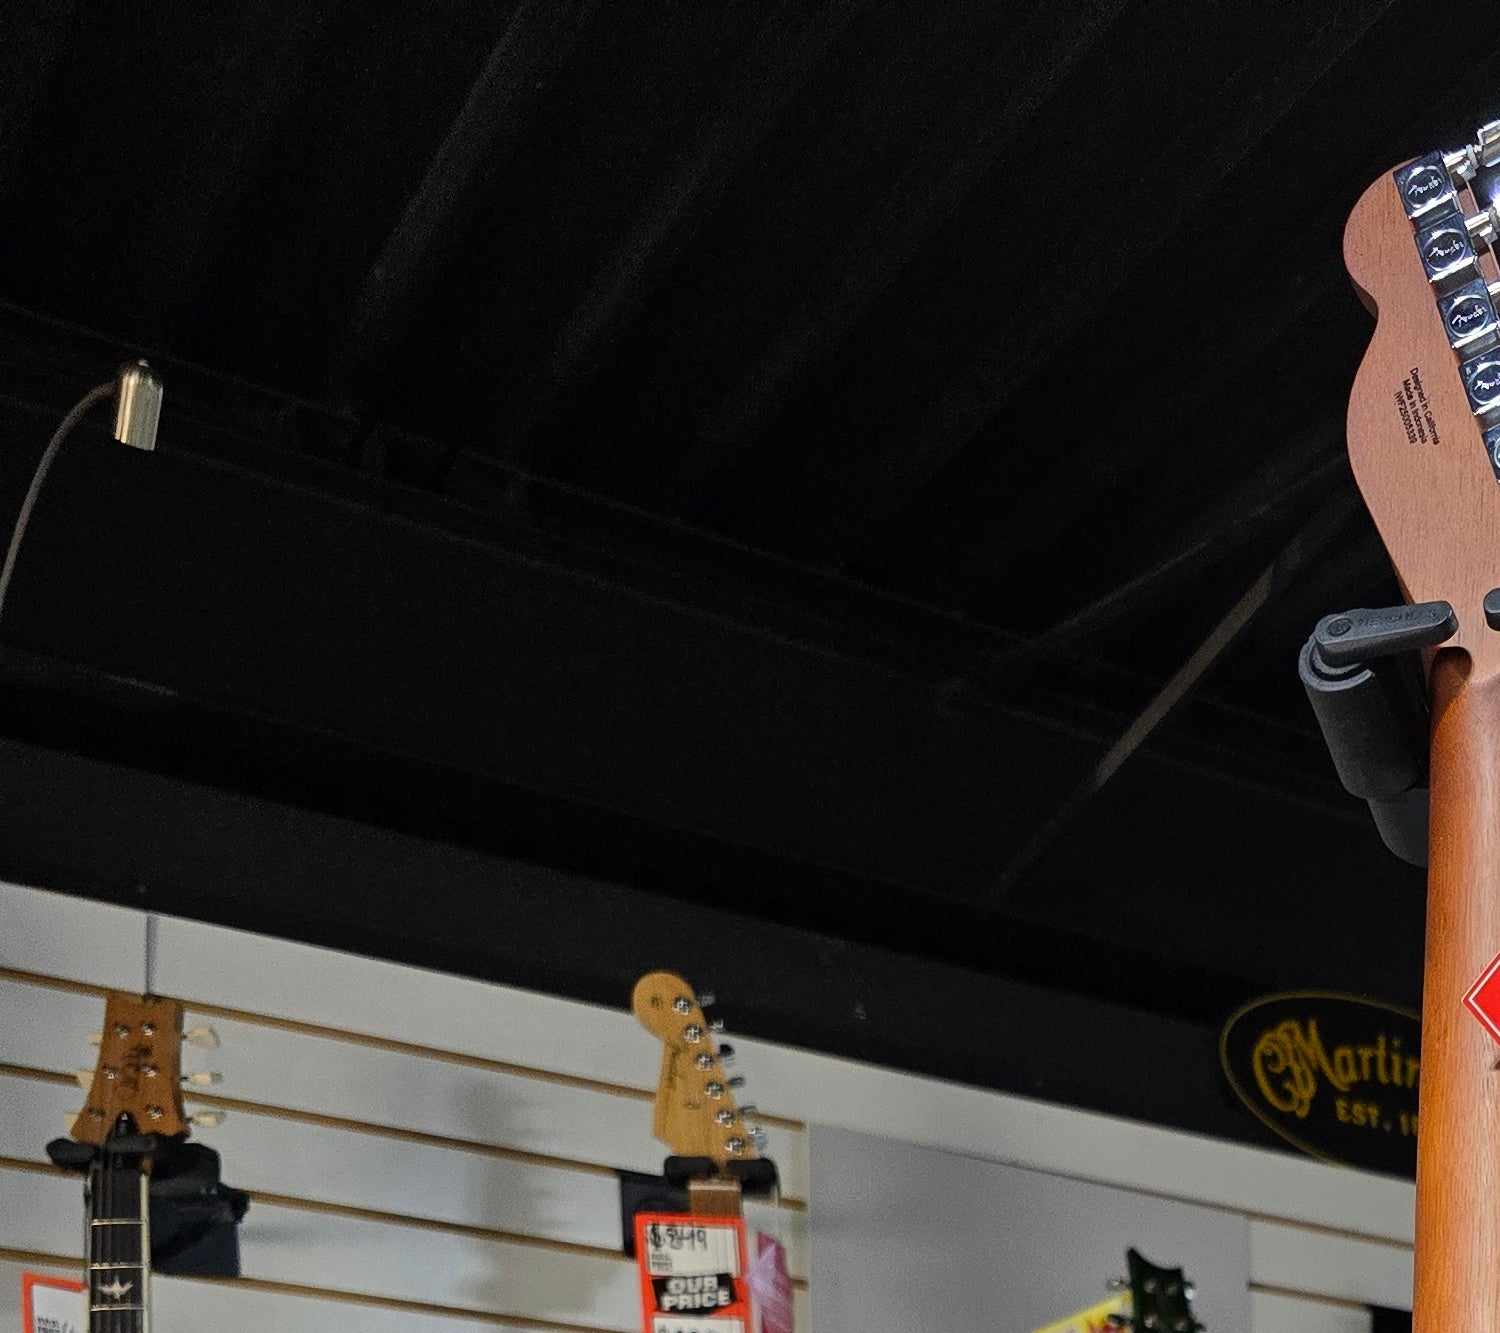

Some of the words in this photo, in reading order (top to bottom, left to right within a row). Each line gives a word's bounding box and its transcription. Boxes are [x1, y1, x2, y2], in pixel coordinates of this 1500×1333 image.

[1402, 378, 1414, 401] Made
[1412, 407, 1427, 445] Indonesia
[1410, 367, 1427, 404] Designed
[1424, 410, 1440, 446] California
[660, 1291, 732, 1312] PRICE
[666, 1276, 719, 1295] OUR
